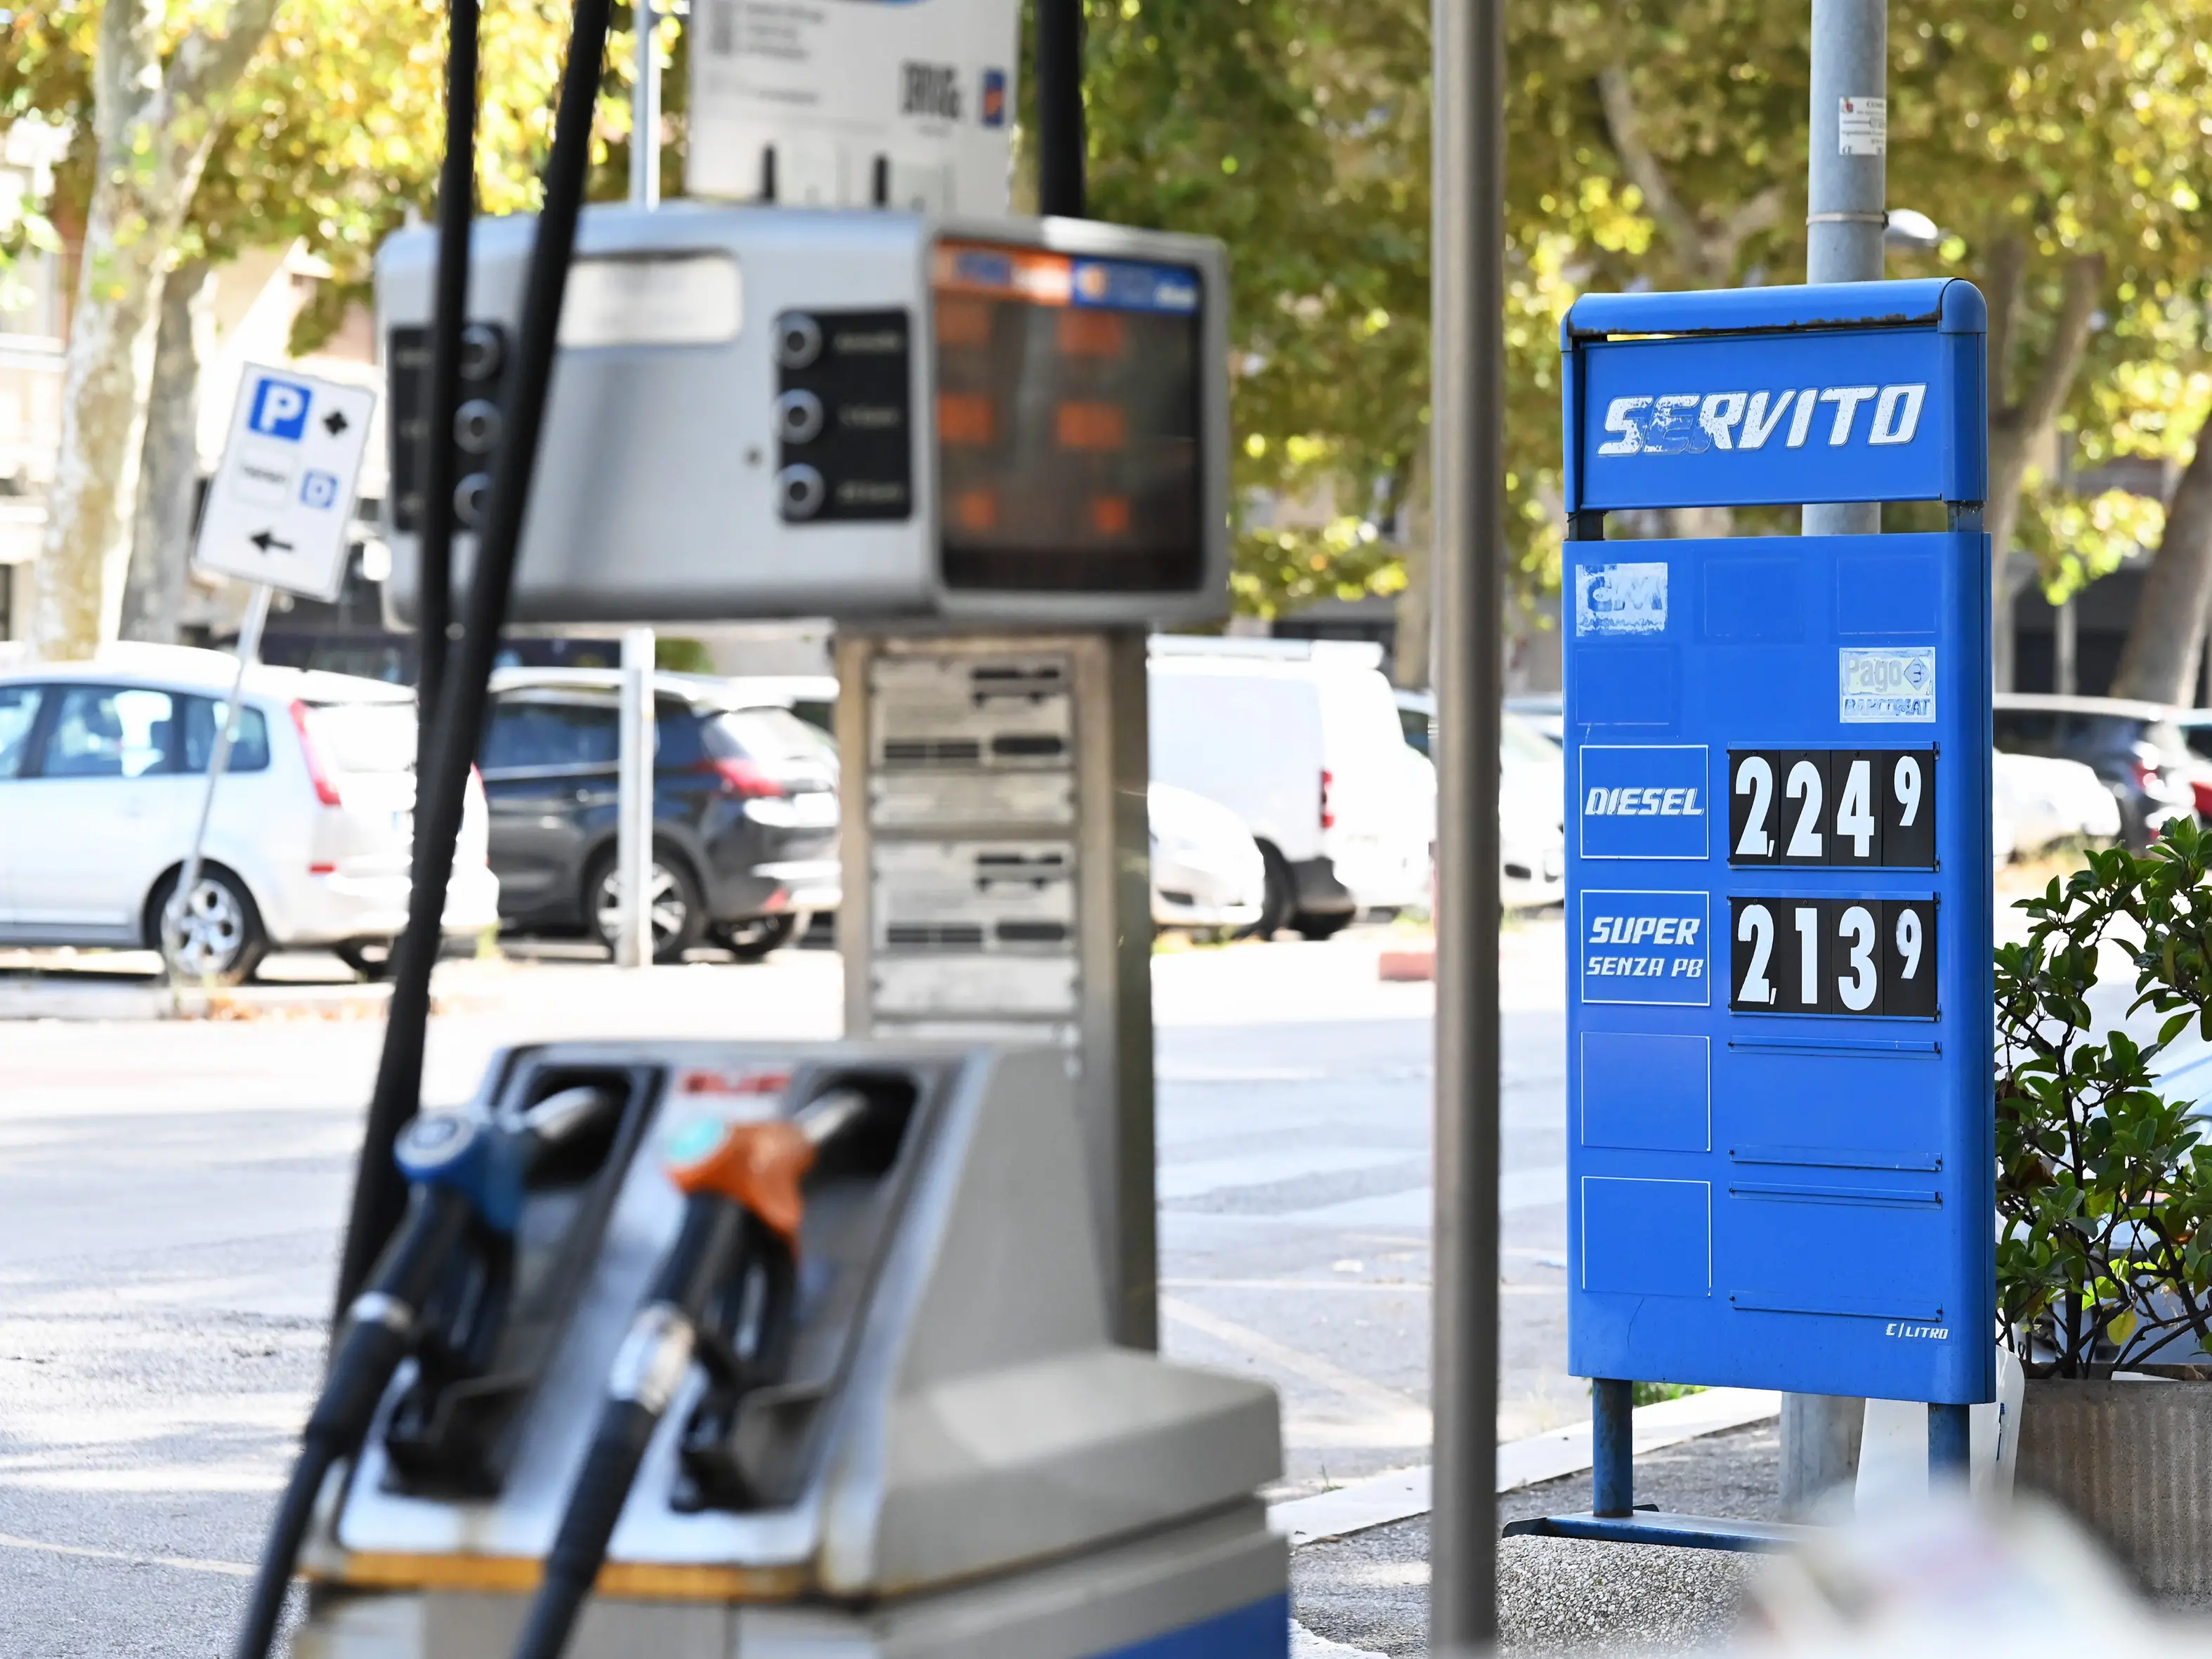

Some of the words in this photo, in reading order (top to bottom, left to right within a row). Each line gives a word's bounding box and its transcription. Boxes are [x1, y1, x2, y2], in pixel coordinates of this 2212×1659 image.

[259, 383, 304, 434] P
[1597, 383, 1927, 457] SERVITO
[1585, 787, 1704, 816] DIESEL
[1588, 917, 1701, 946] SUPER
[1586, 957, 1665, 977] SENZA
[1671, 958, 1704, 978] PB
